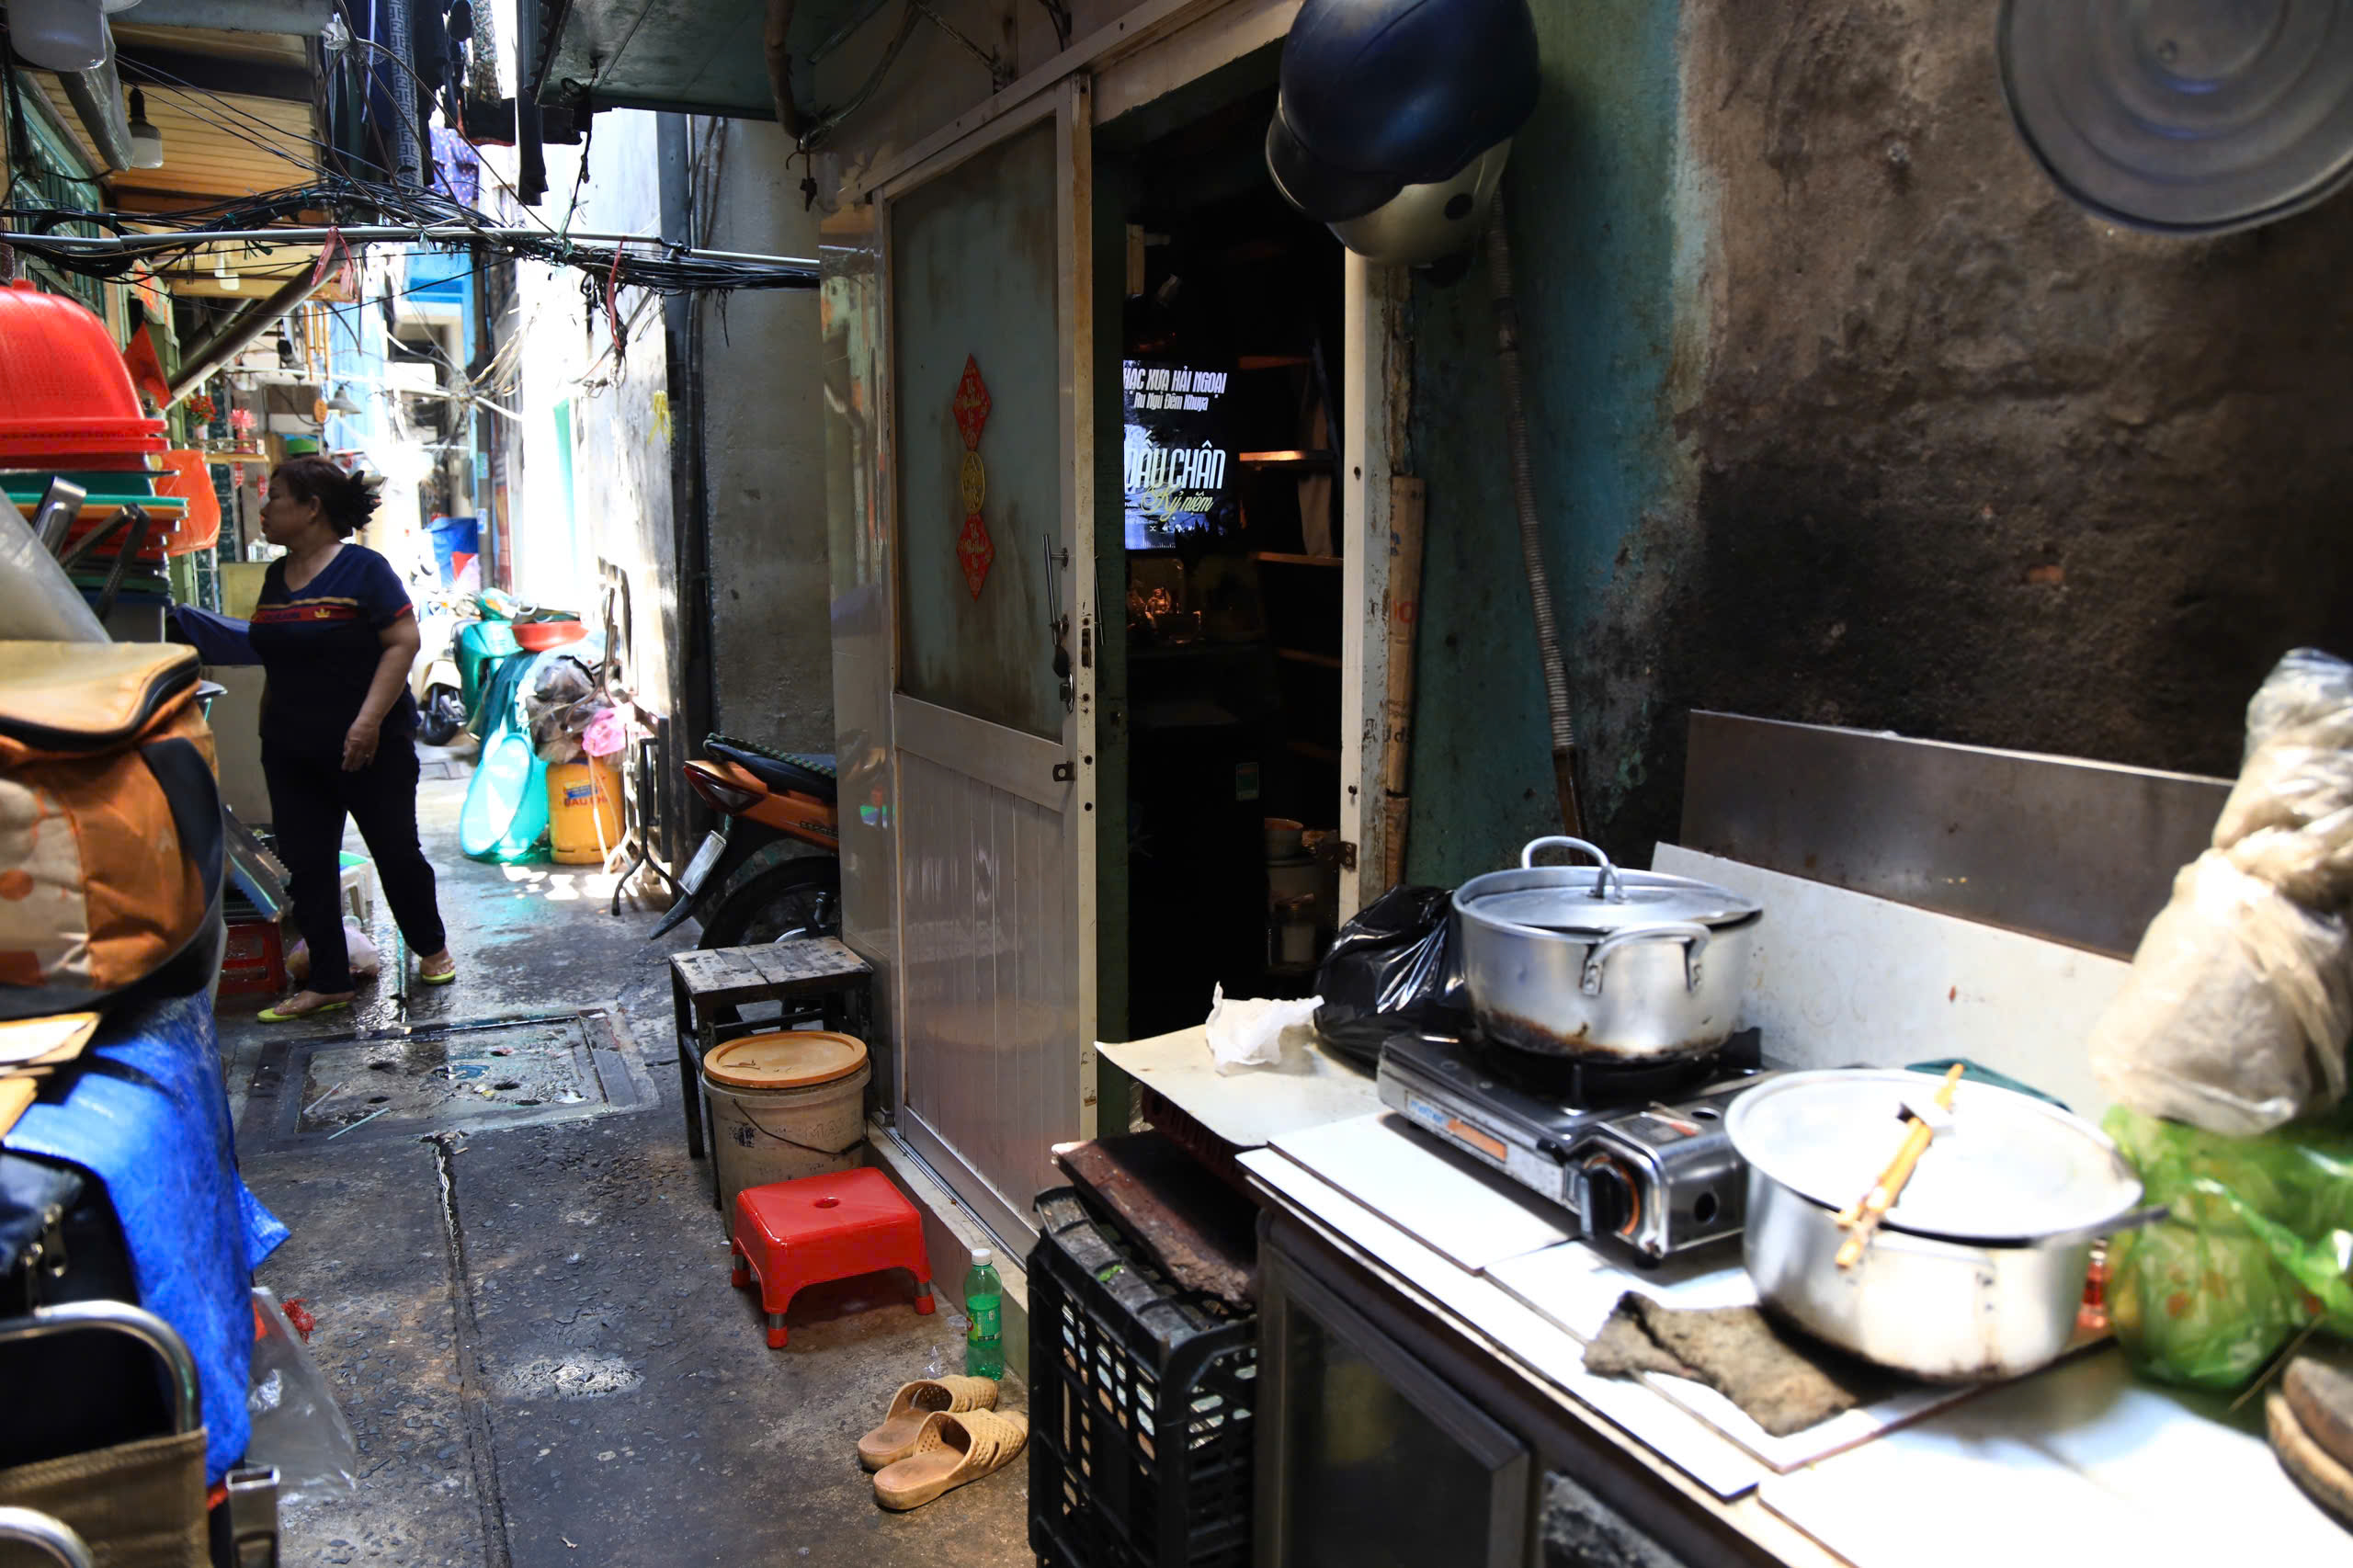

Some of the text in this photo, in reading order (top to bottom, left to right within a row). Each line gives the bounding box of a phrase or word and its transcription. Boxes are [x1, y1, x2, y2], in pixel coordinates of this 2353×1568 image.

[1145, 369, 1170, 391] XƯA
[1171, 366, 1192, 392] HẢI
[1192, 371, 1227, 398] NGOẠI
[1133, 392, 1209, 412] Ru Ngủ Đêm Khuya
[1168, 439, 1226, 489] CHÂN
